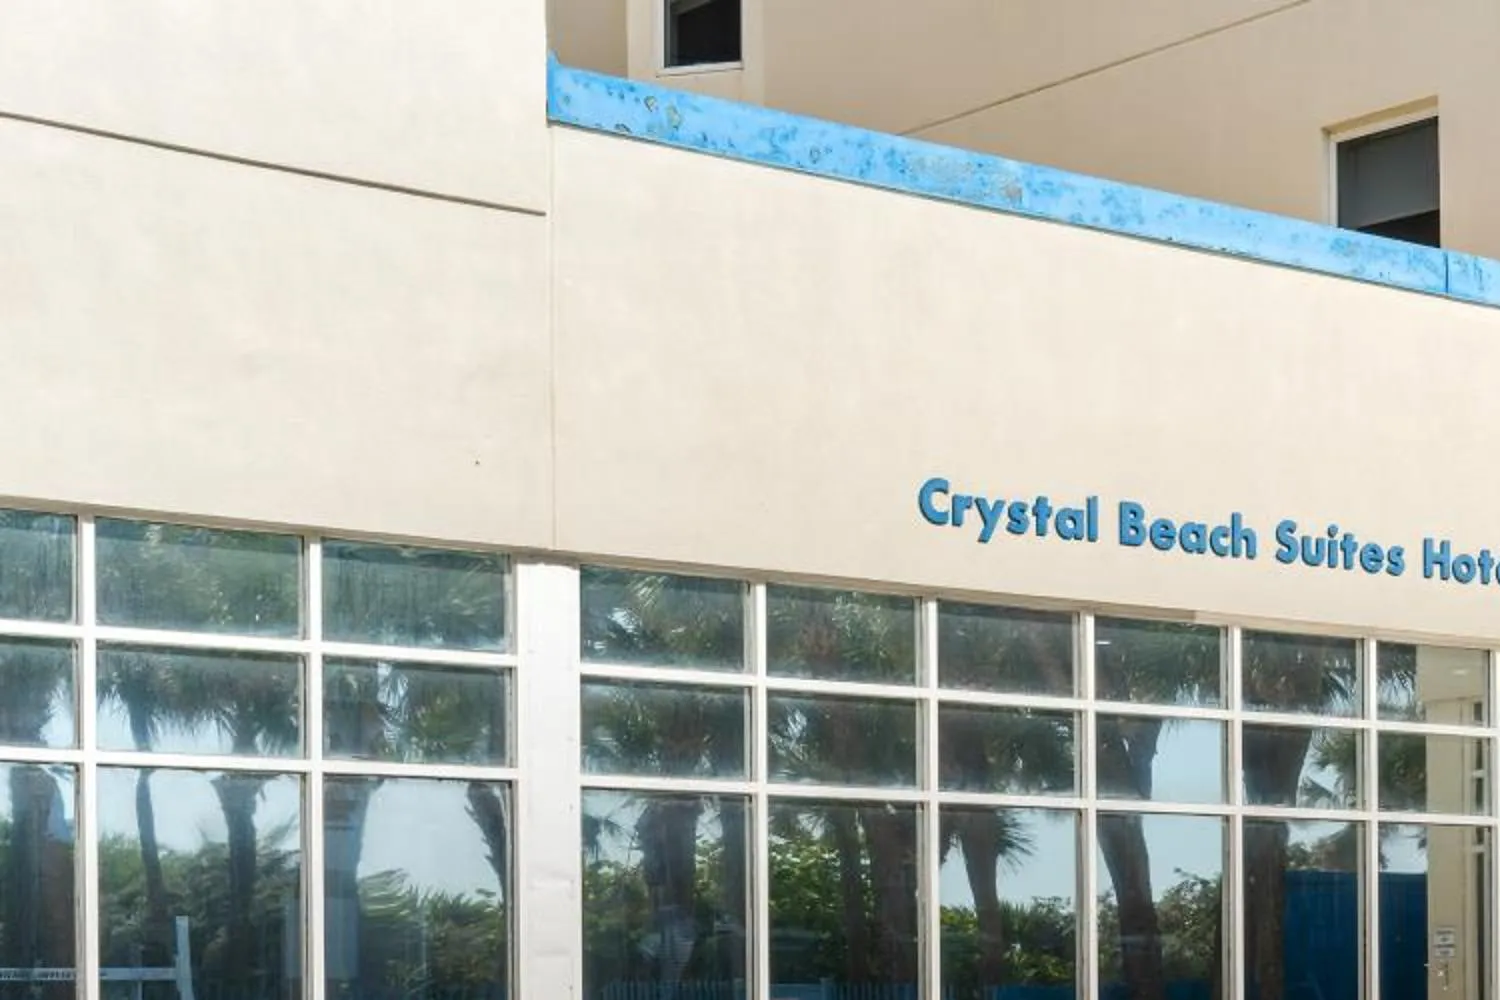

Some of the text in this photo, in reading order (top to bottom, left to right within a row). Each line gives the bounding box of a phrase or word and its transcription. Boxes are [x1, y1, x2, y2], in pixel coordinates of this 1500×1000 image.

[918, 477, 1099, 543] Crystal
[1118, 501, 1257, 559] Beach
[1275, 519, 1406, 577] Suites
